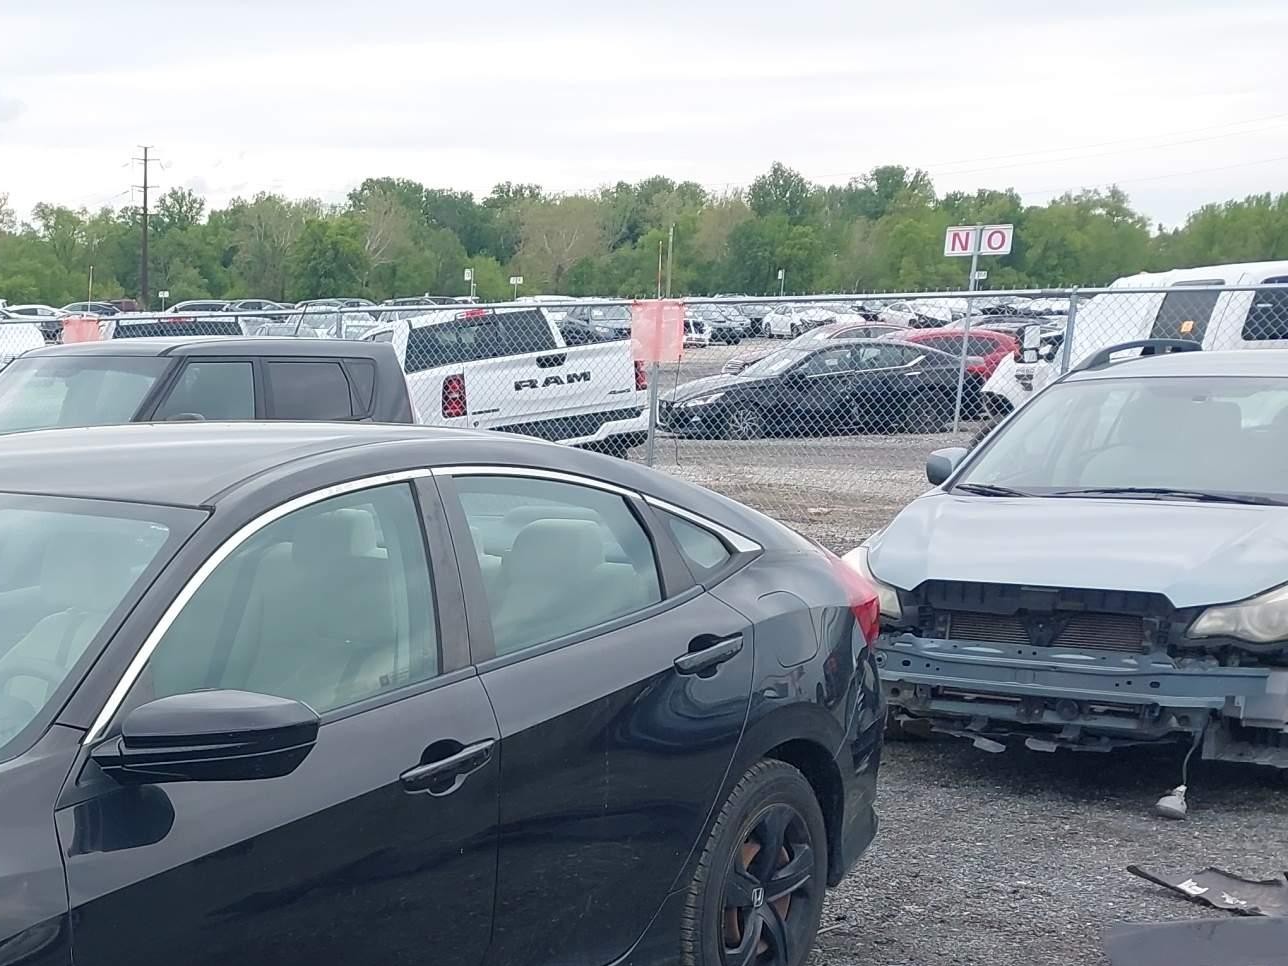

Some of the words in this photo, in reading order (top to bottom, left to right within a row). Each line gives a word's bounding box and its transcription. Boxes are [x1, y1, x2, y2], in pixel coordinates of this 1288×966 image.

[951, 231, 970, 251] N
[987, 230, 1006, 251] O
[514, 371, 591, 392] RAM
